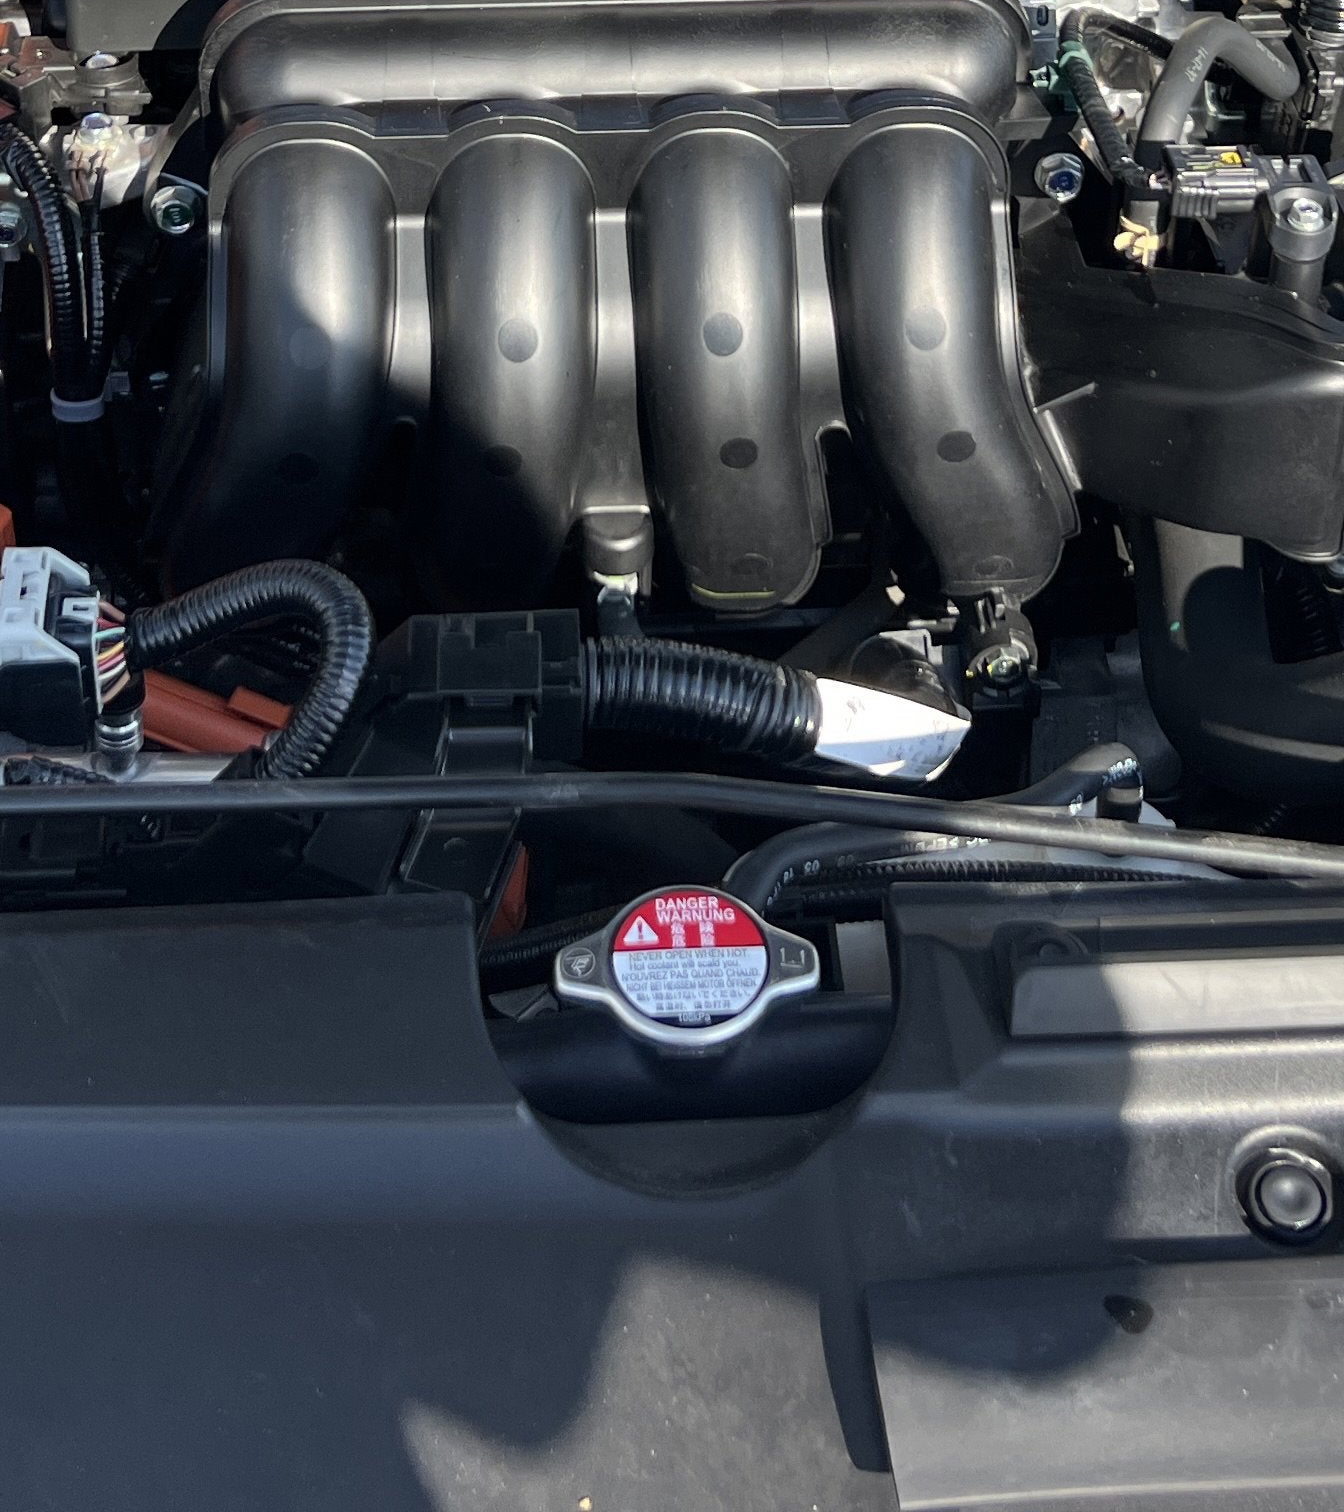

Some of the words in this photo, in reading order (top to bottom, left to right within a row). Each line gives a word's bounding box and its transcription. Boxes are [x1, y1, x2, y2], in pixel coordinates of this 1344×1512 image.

[656, 896, 718, 912] DANGER
[656, 908, 736, 924] WARNUNG
[628, 952, 662, 962] NEVER
[665, 950, 692, 960] OPEN
[695, 949, 725, 959] WHEN
[629, 961, 645, 971] Hot
[647, 960, 679, 970] coolant
[697, 959, 721, 967] scald
[669, 969, 689, 980] PAS
[690, 968, 724, 979] QUAND
